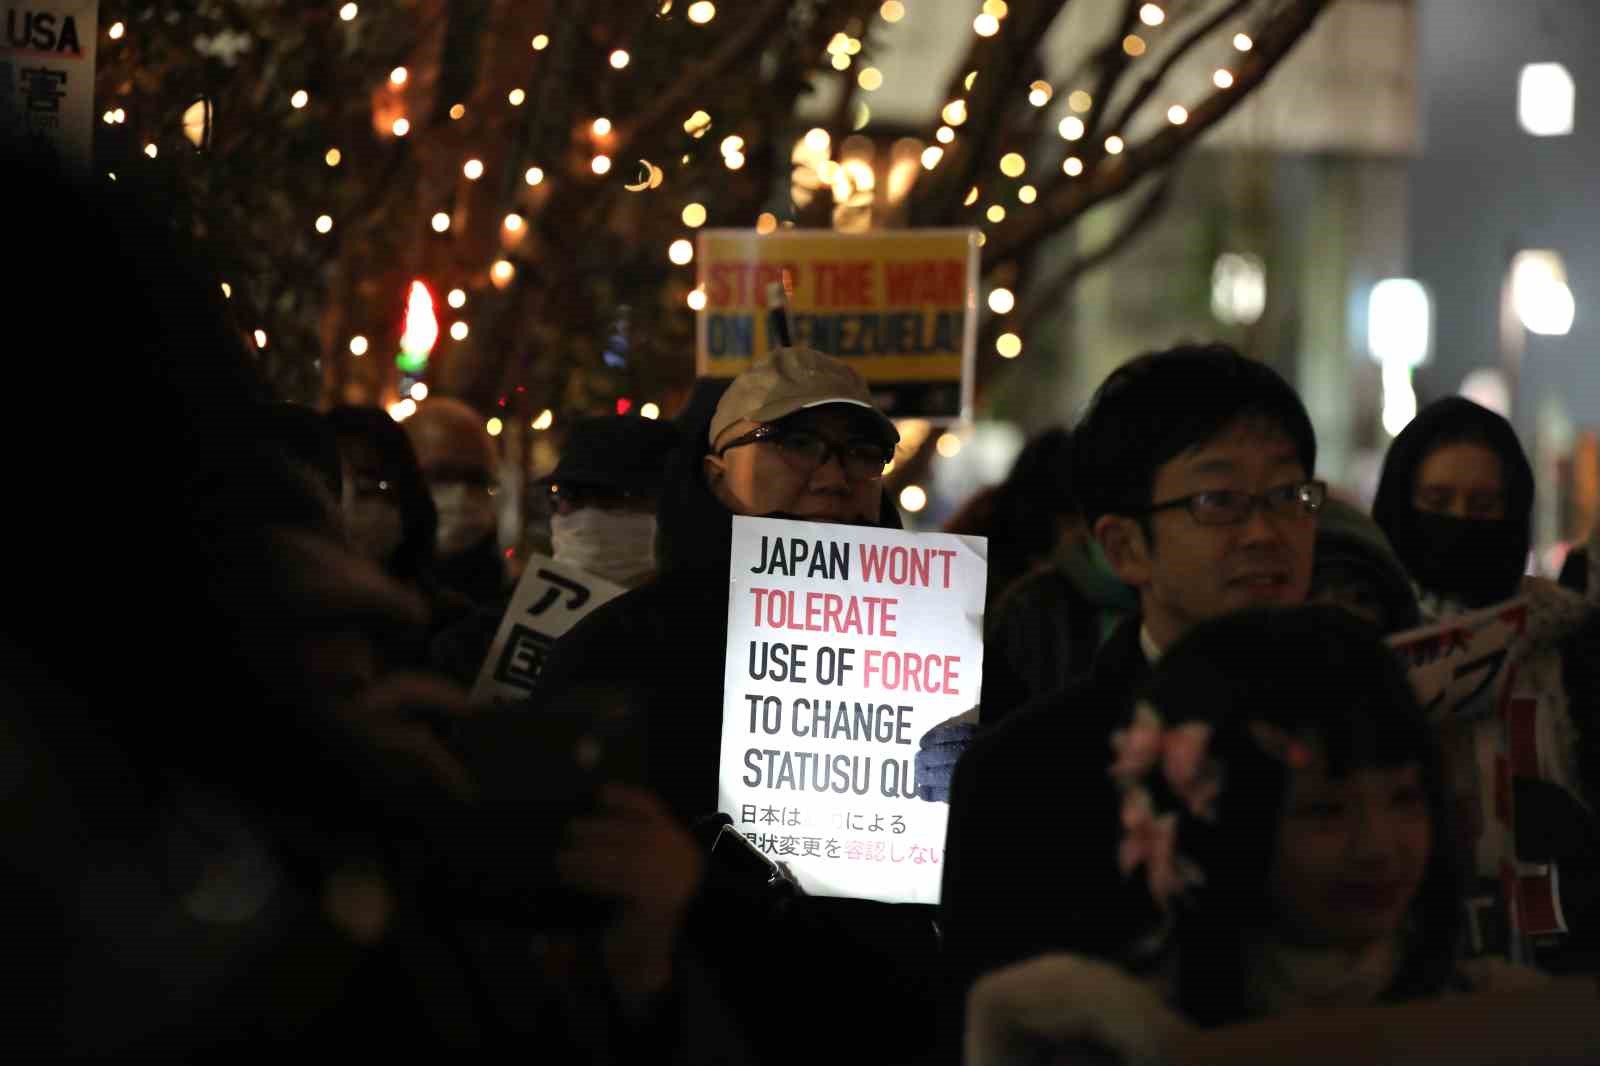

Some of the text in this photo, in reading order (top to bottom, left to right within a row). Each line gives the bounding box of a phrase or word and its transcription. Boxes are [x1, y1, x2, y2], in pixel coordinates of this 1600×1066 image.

[8, 8, 80, 53] USA
[811, 260, 872, 305] THE
[885, 259, 965, 305] WAR
[709, 314, 755, 357] ON
[750, 536, 957, 589] JAPAN WON'T
[750, 588, 898, 637] TOLERATE
[749, 641, 961, 694] USE OF FORCE
[745, 694, 914, 745] TO CHANGE
[742, 748, 871, 795] STATUSU
